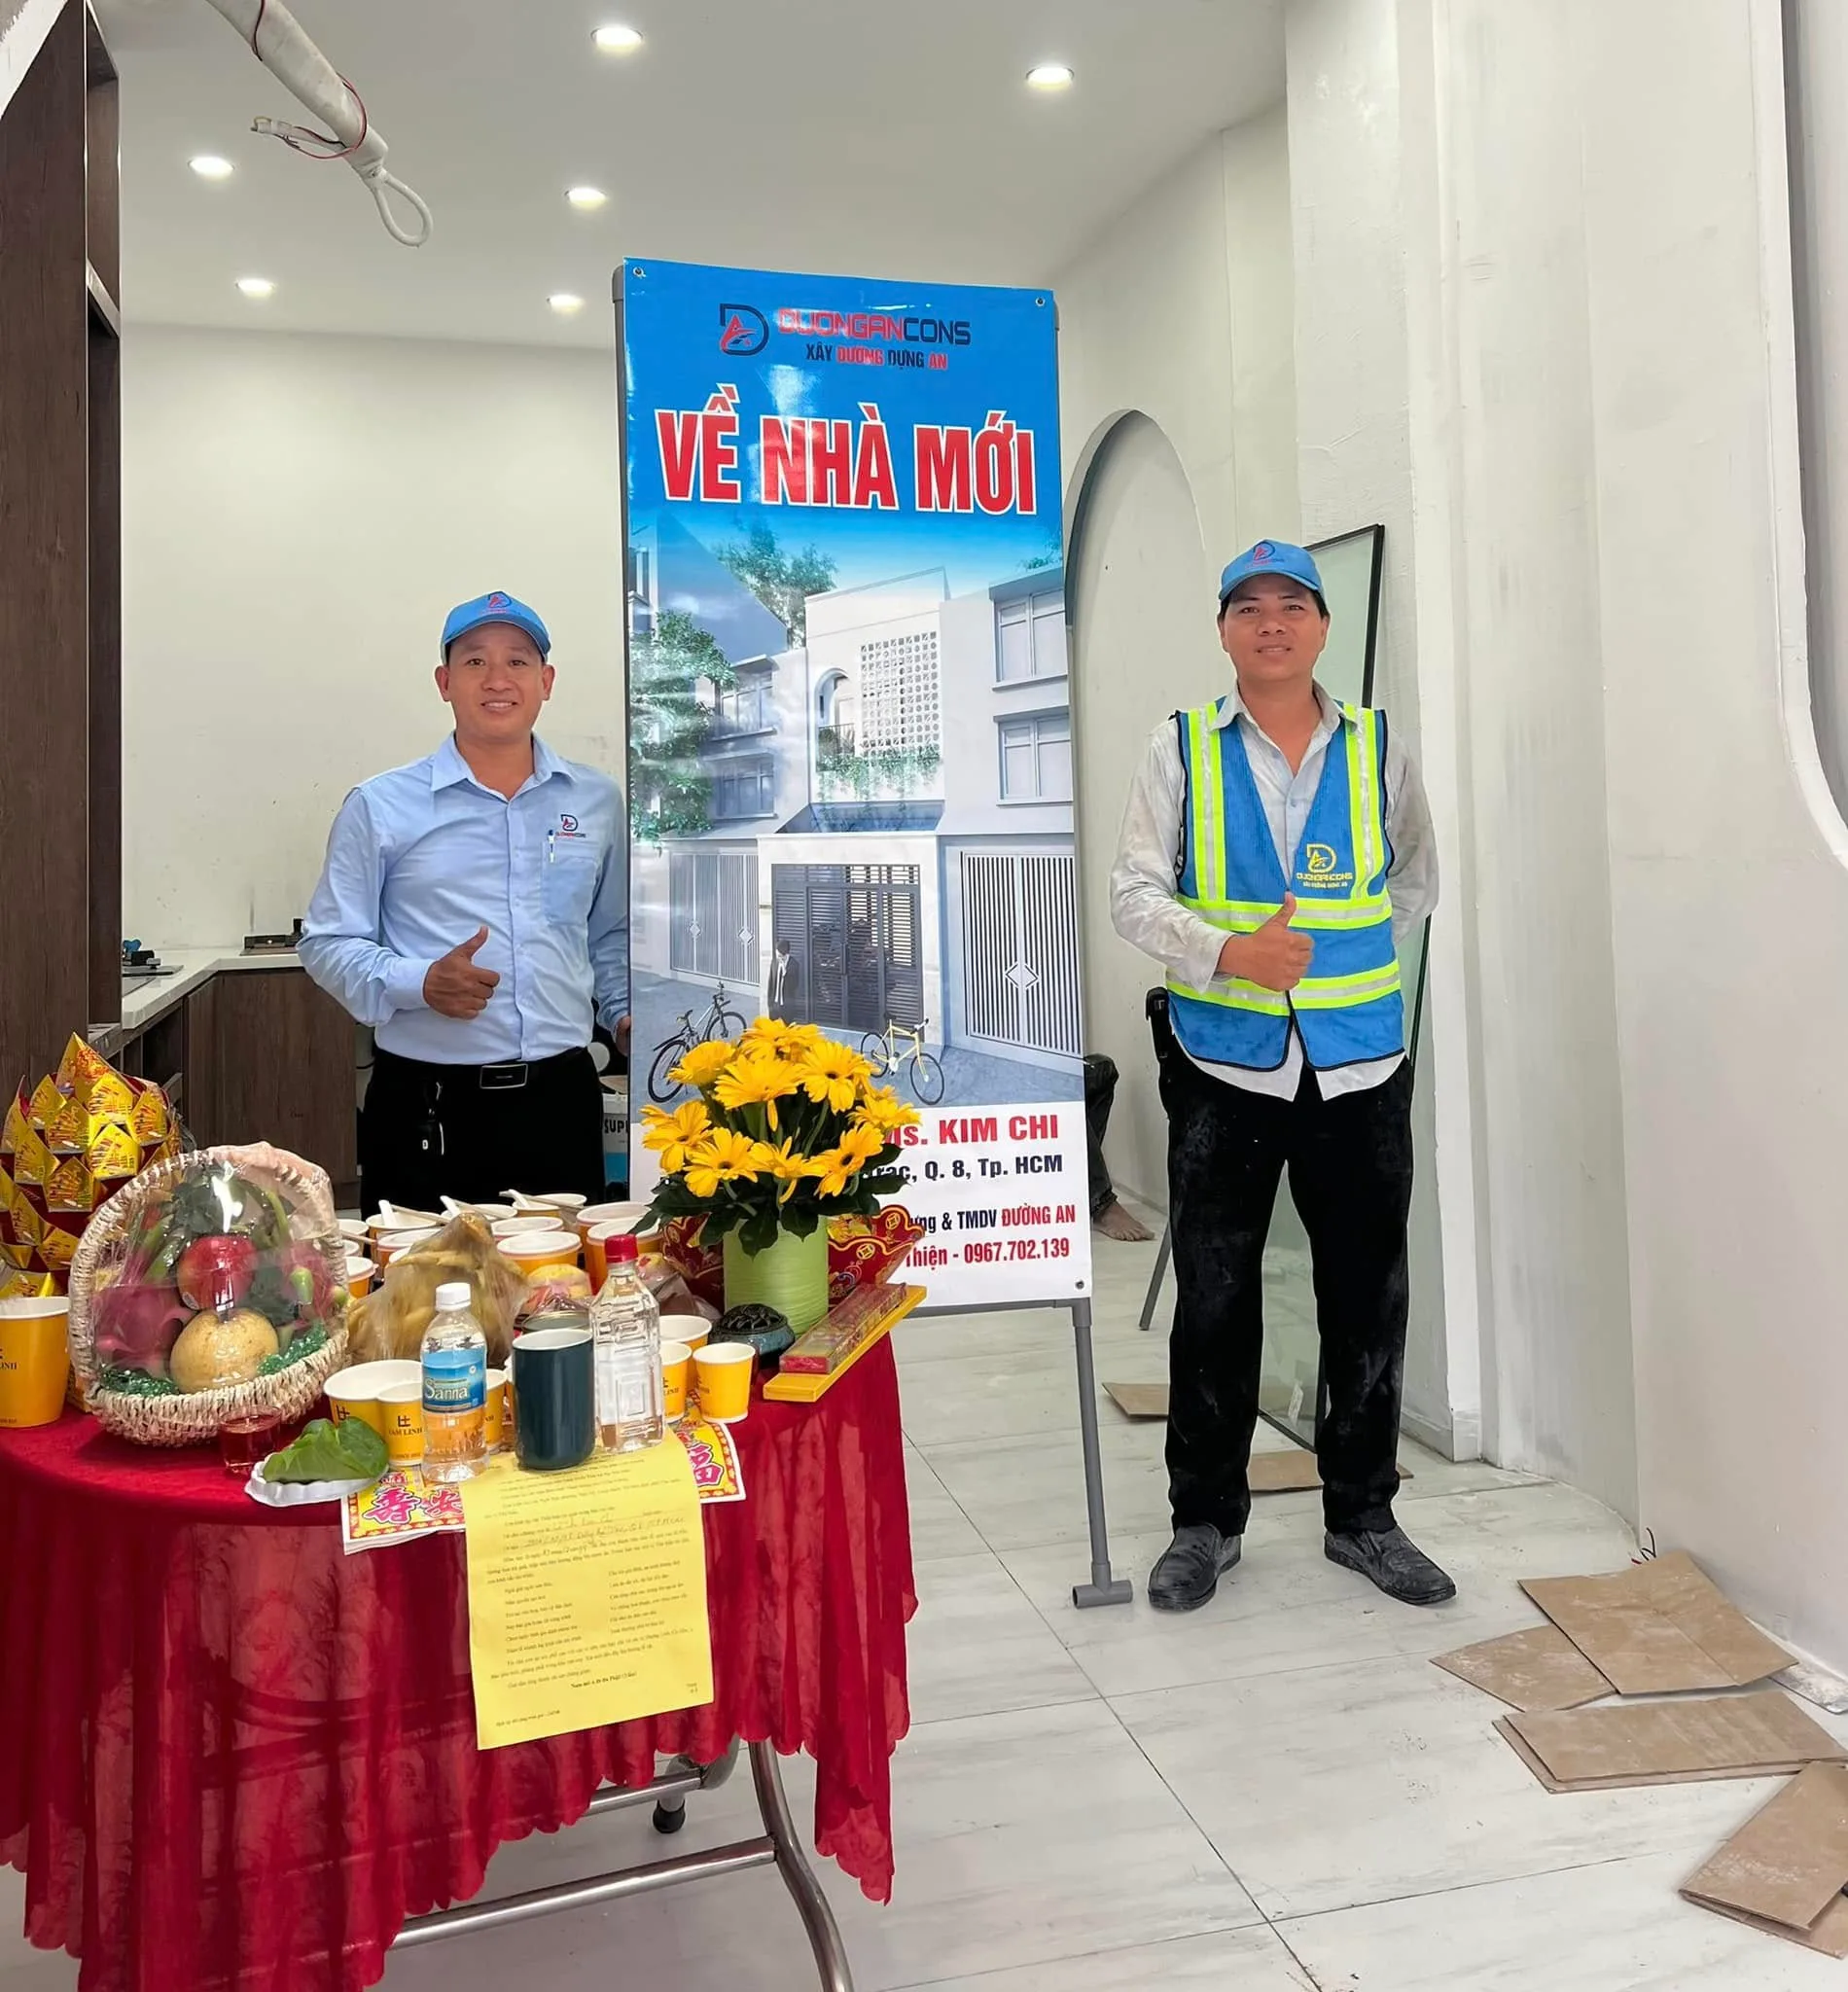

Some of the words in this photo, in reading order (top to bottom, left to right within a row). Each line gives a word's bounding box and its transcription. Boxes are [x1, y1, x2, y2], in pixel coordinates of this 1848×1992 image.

[806, 341, 833, 362] XÂY
[928, 352, 948, 370] AN
[655, 383, 742, 503] VỀ
[760, 402, 900, 511] NHÀ
[914, 409, 1038, 515] MỚI
[604, 1119, 628, 1134] SUP
[939, 1117, 998, 1145] KIM
[1009, 1115, 1058, 1141] CHI
[925, 1161, 945, 1181] Q.
[952, 1159, 971, 1180] 8,
[977, 1158, 1009, 1178] Tp.
[1015, 1155, 1062, 1174] HCM
[942, 1212, 952, 1230] &
[957, 1209, 997, 1229] TMDV
[1002, 1202, 1051, 1227] ĐƯỜNG
[1055, 1204, 1076, 1224] AN
[964, 1237, 1070, 1263] 0967.702.139
[425, 1376, 468, 1401] Sanna
